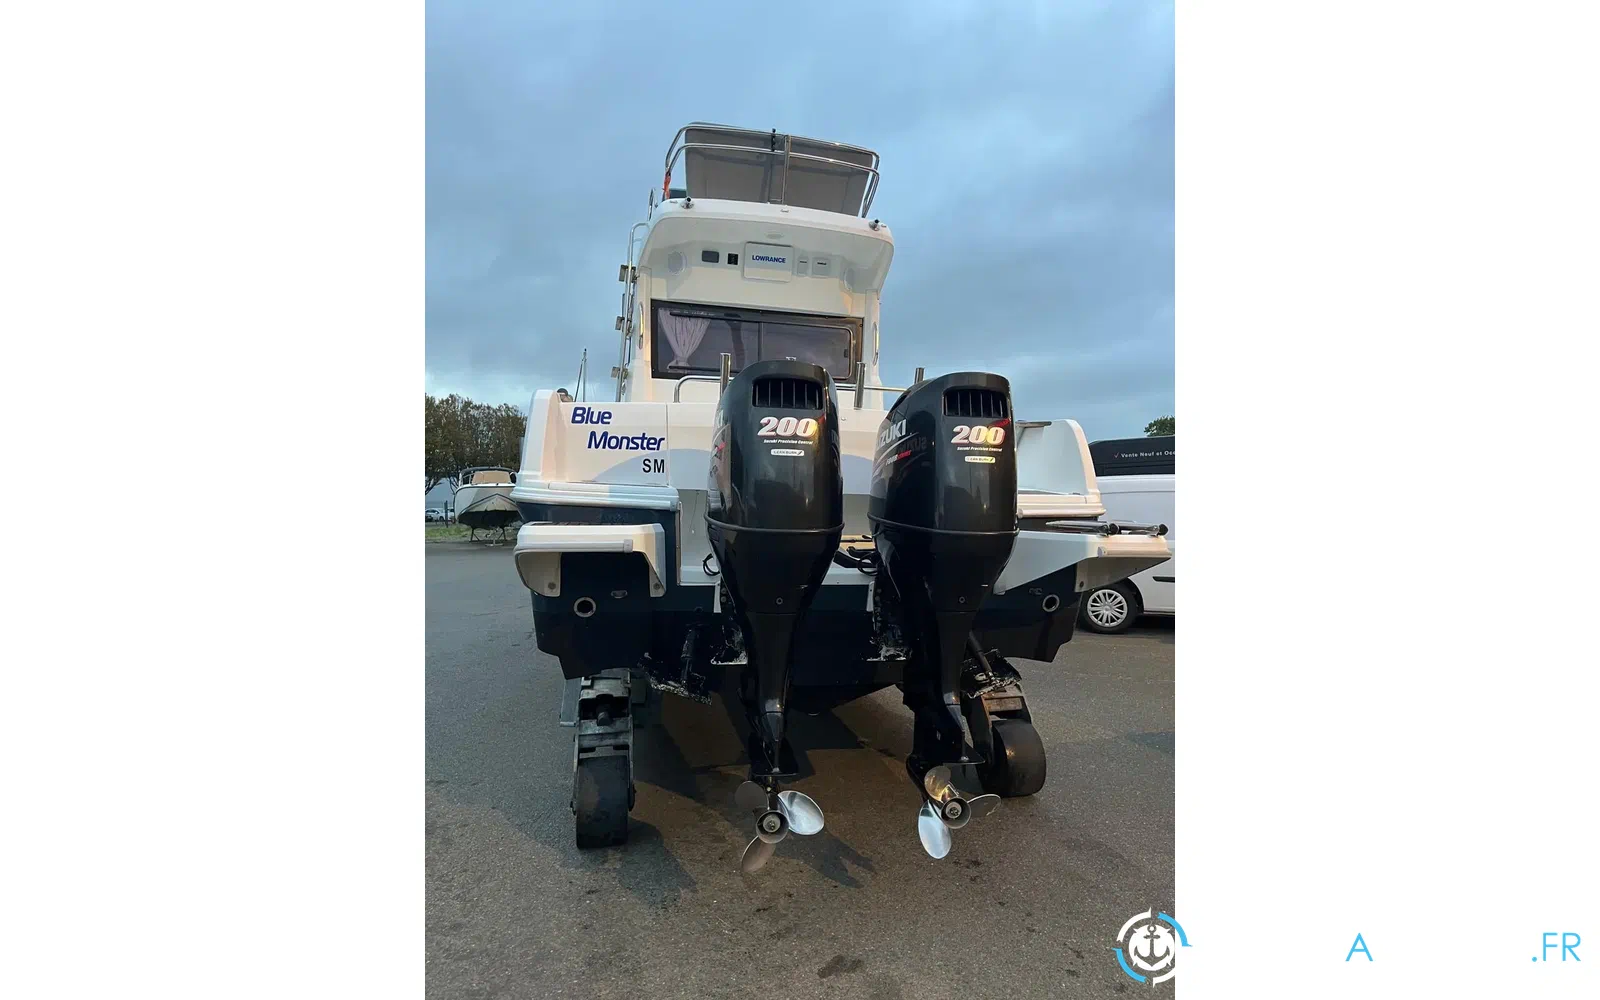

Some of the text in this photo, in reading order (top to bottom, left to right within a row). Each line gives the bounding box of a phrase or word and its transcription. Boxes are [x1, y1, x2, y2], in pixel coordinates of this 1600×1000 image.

[751, 254, 787, 264] LOWRANCE
[571, 406, 612, 424] Blue
[757, 416, 818, 437] 200
[951, 425, 1005, 446] 200
[587, 430, 666, 451] Monster
[642, 458, 665, 474] SM
